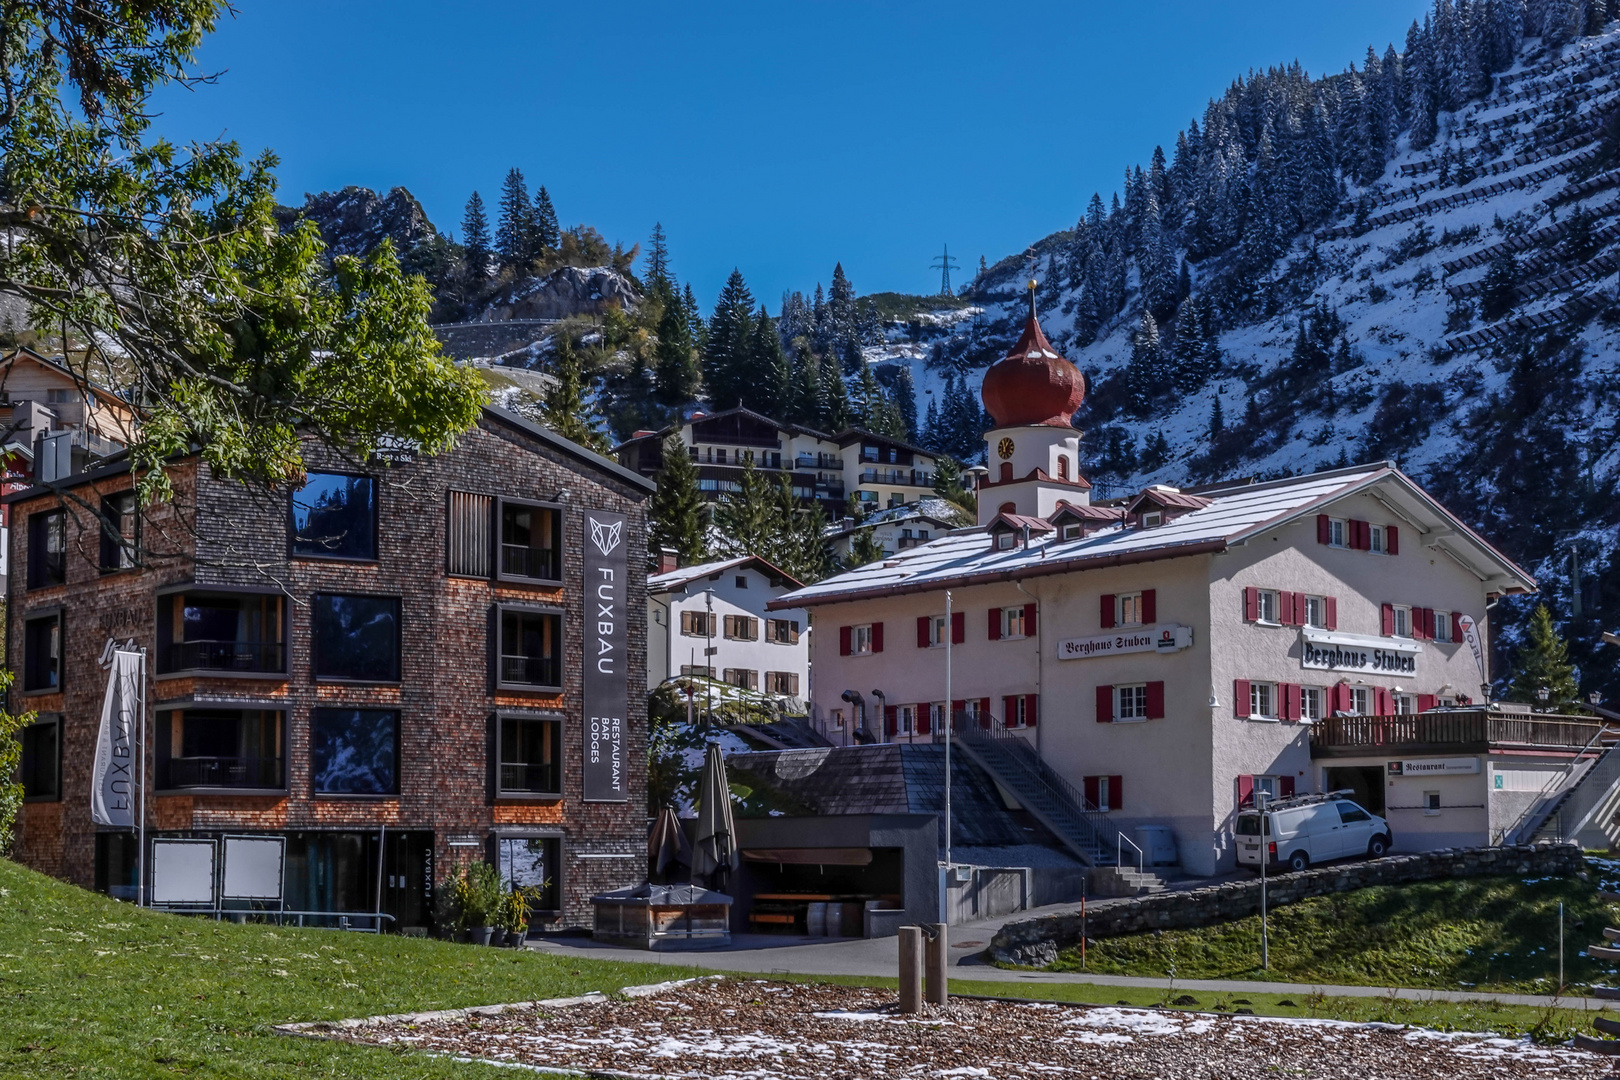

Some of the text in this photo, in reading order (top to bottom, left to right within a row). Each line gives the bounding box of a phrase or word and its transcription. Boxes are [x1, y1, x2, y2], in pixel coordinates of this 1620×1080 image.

[400, 454, 412, 463] Ski
[597, 567, 614, 674] FUXBAU
[1065, 640, 1112, 655] Berghaus
[1115, 636, 1151, 649] Stuben
[1304, 642, 1416, 673] Berghaus Stuben
[591, 717, 600, 764] LODGES
[601, 717, 610, 741] BAR
[612, 718, 621, 792] RESTAURANT
[1405, 763, 1445, 772] Restaurant
